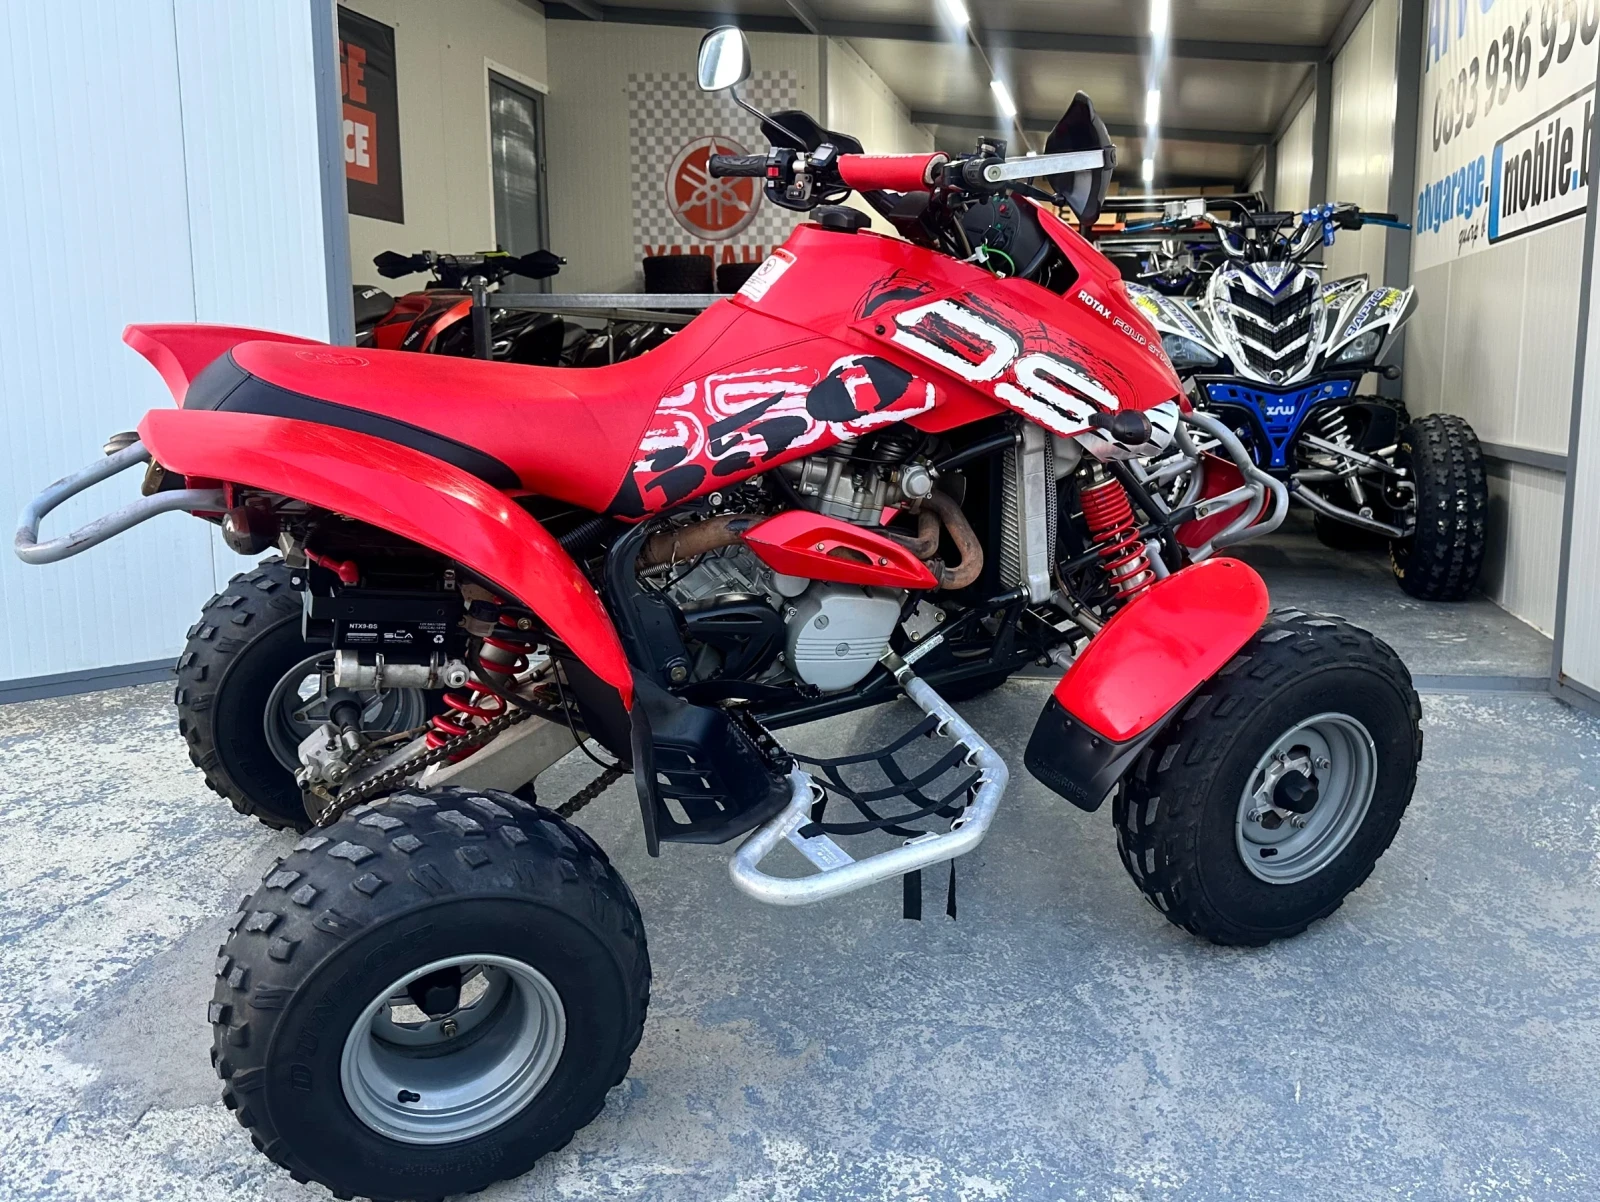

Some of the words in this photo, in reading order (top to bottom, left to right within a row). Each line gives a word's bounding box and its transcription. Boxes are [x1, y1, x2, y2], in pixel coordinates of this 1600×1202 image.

[1433, 56, 1480, 152] 0893
[1484, 7, 1532, 117] 936
[1077, 290, 1112, 319] ROTAX
[1112, 315, 1147, 346] FOUR
[288, 922, 435, 1092] DUNLOP
